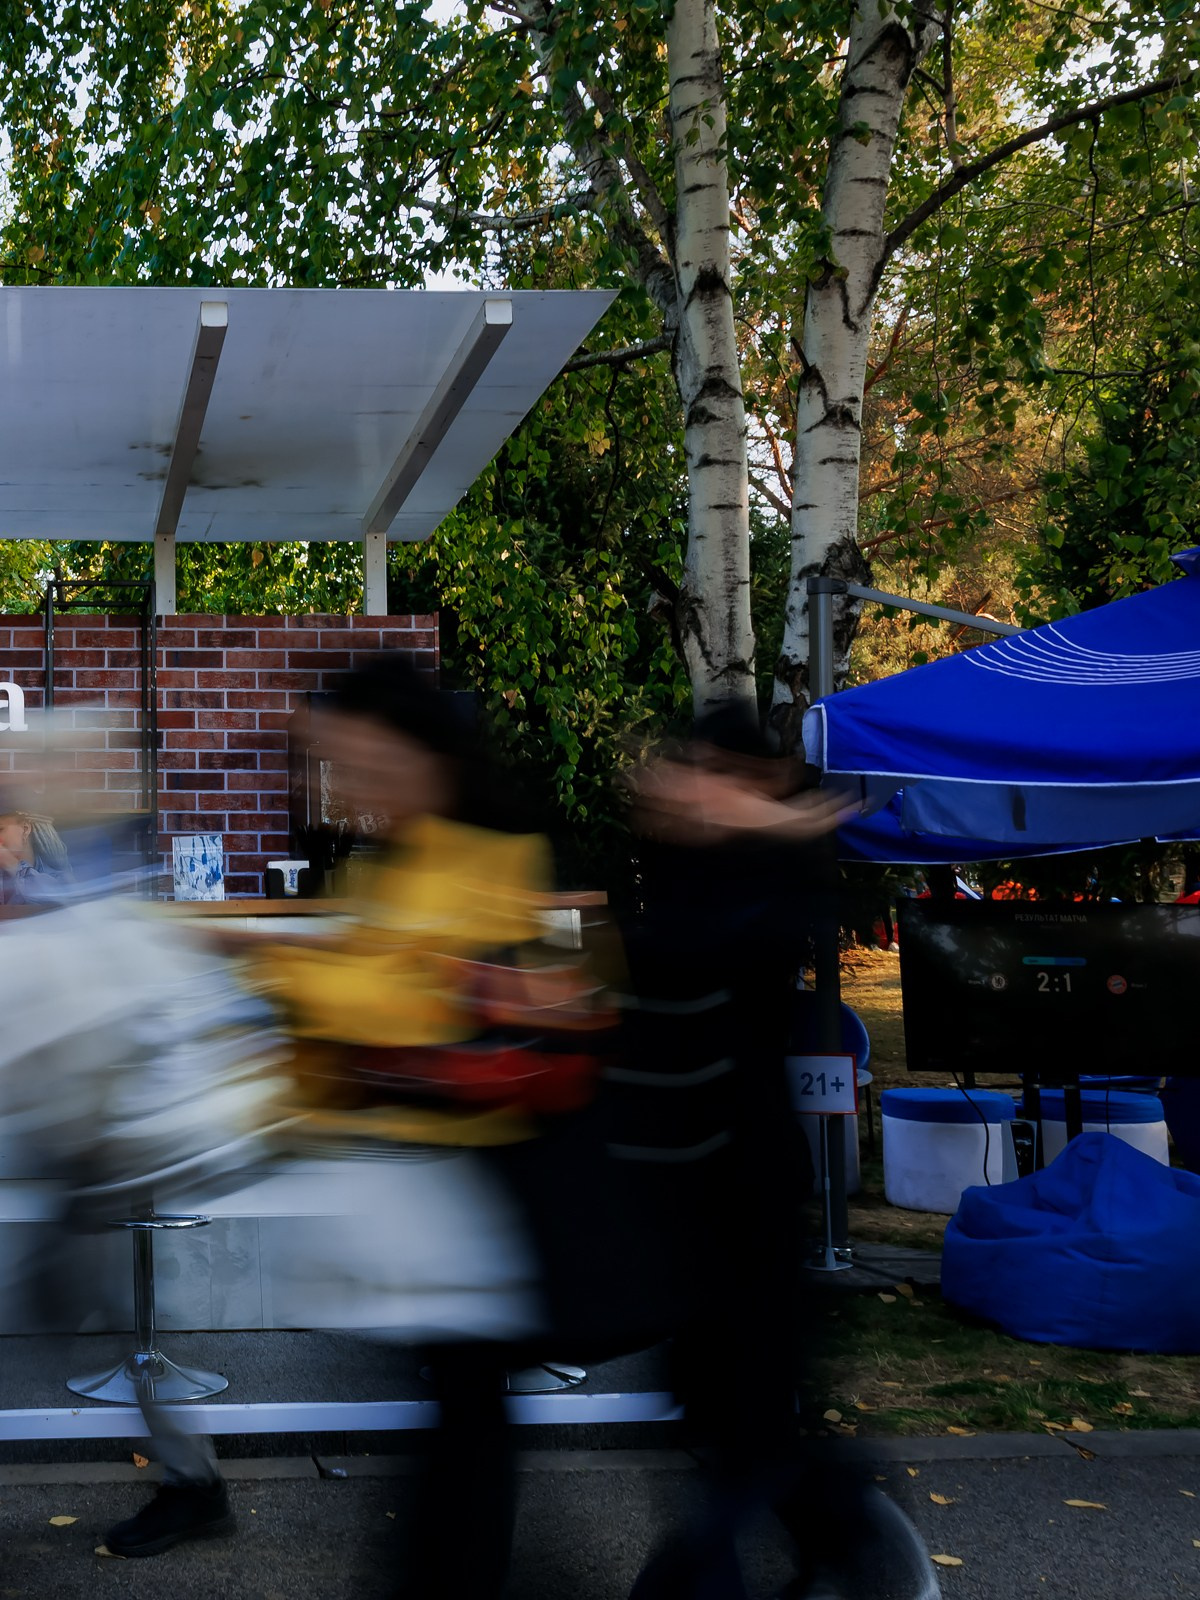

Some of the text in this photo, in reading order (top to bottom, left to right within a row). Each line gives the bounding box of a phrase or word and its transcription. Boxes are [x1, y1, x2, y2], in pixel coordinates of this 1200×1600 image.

[1014, 913, 1088, 923] РЕЗУЛЬТАТ МАТЧА
[1036, 972, 1072, 992] 2:1
[800, 1072, 845, 1096] 21+
